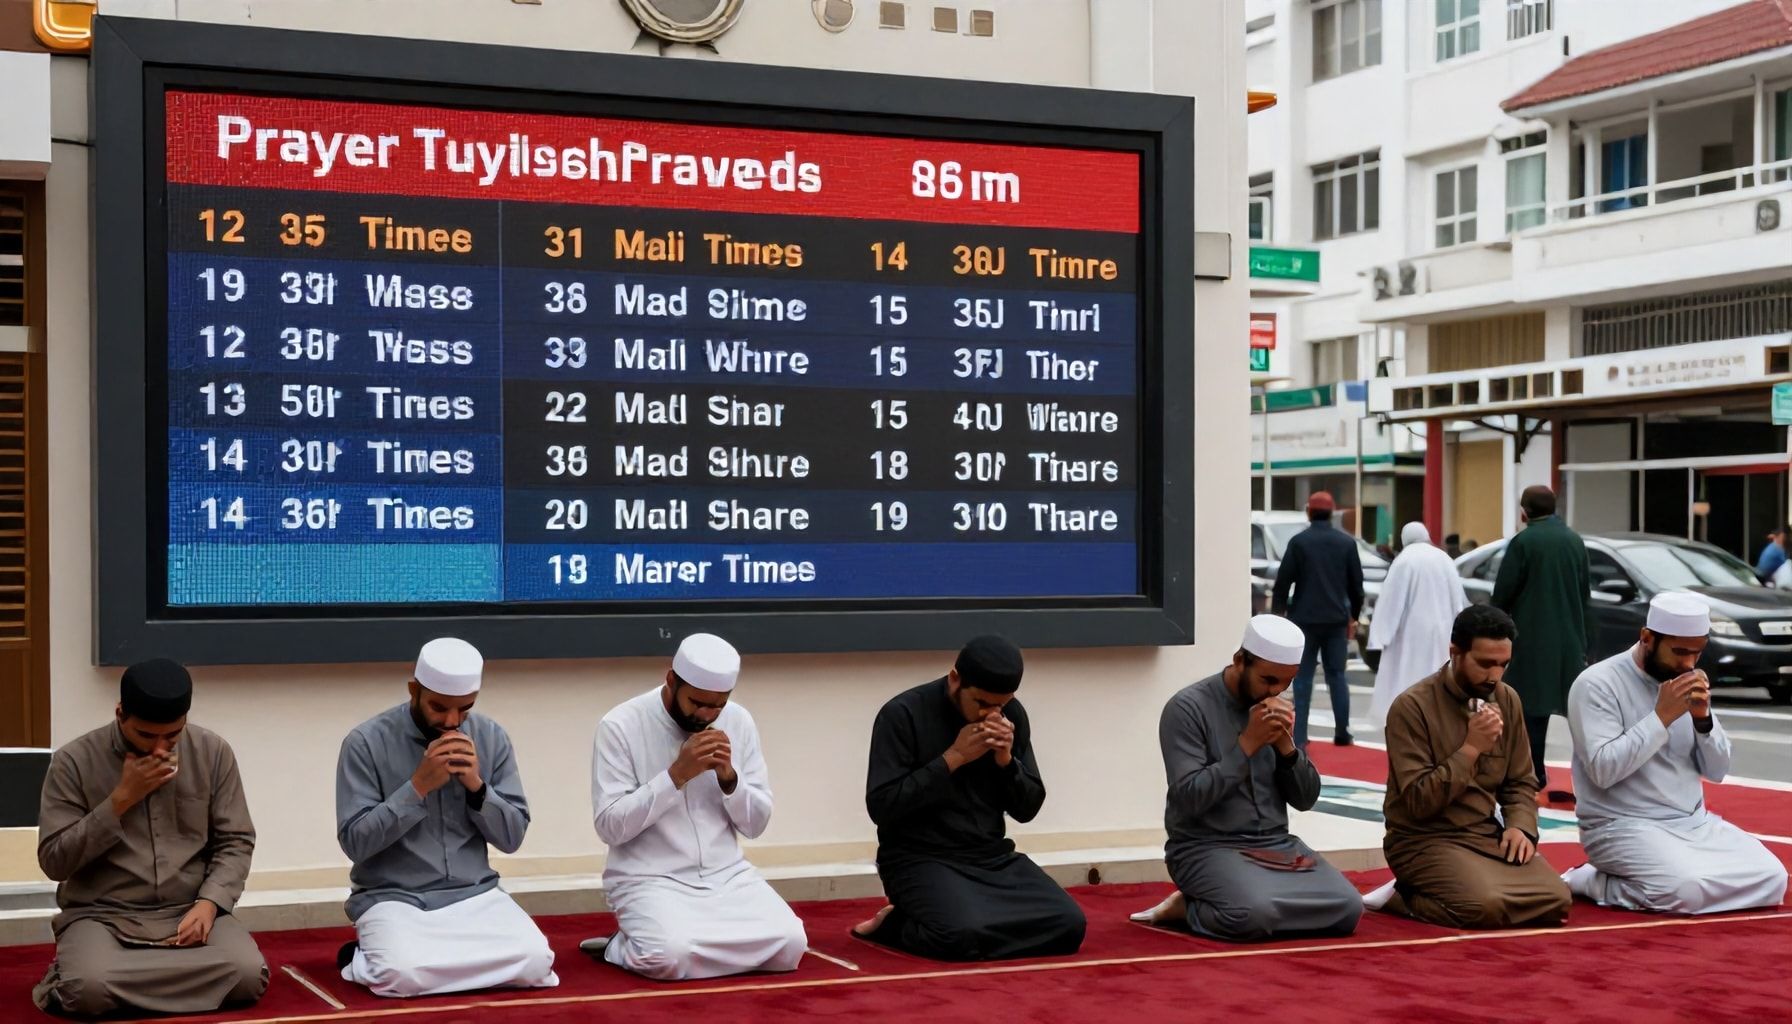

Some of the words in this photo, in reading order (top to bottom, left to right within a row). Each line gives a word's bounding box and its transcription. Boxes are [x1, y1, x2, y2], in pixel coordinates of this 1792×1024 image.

[218, 115, 399, 177] Prayer
[199, 210, 244, 242] 12
[280, 213, 325, 246] 35
[545, 226, 581, 258] 31
[704, 234, 802, 267] Times
[871, 242, 908, 270] 14
[199, 268, 245, 301] 19
[615, 284, 687, 316] Mad
[870, 295, 907, 325] 15
[200, 325, 245, 358] 12
[871, 346, 906, 376] 15
[200, 383, 245, 416] 13
[546, 392, 586, 422] 22
[871, 400, 907, 429] 15
[200, 438, 248, 471] 14
[616, 446, 687, 476] Mad
[871, 451, 908, 480] 18
[201, 497, 251, 529] 14
[546, 499, 587, 529] 20
[709, 500, 809, 530] Share
[871, 501, 907, 530] 19
[723, 554, 815, 583] Times
